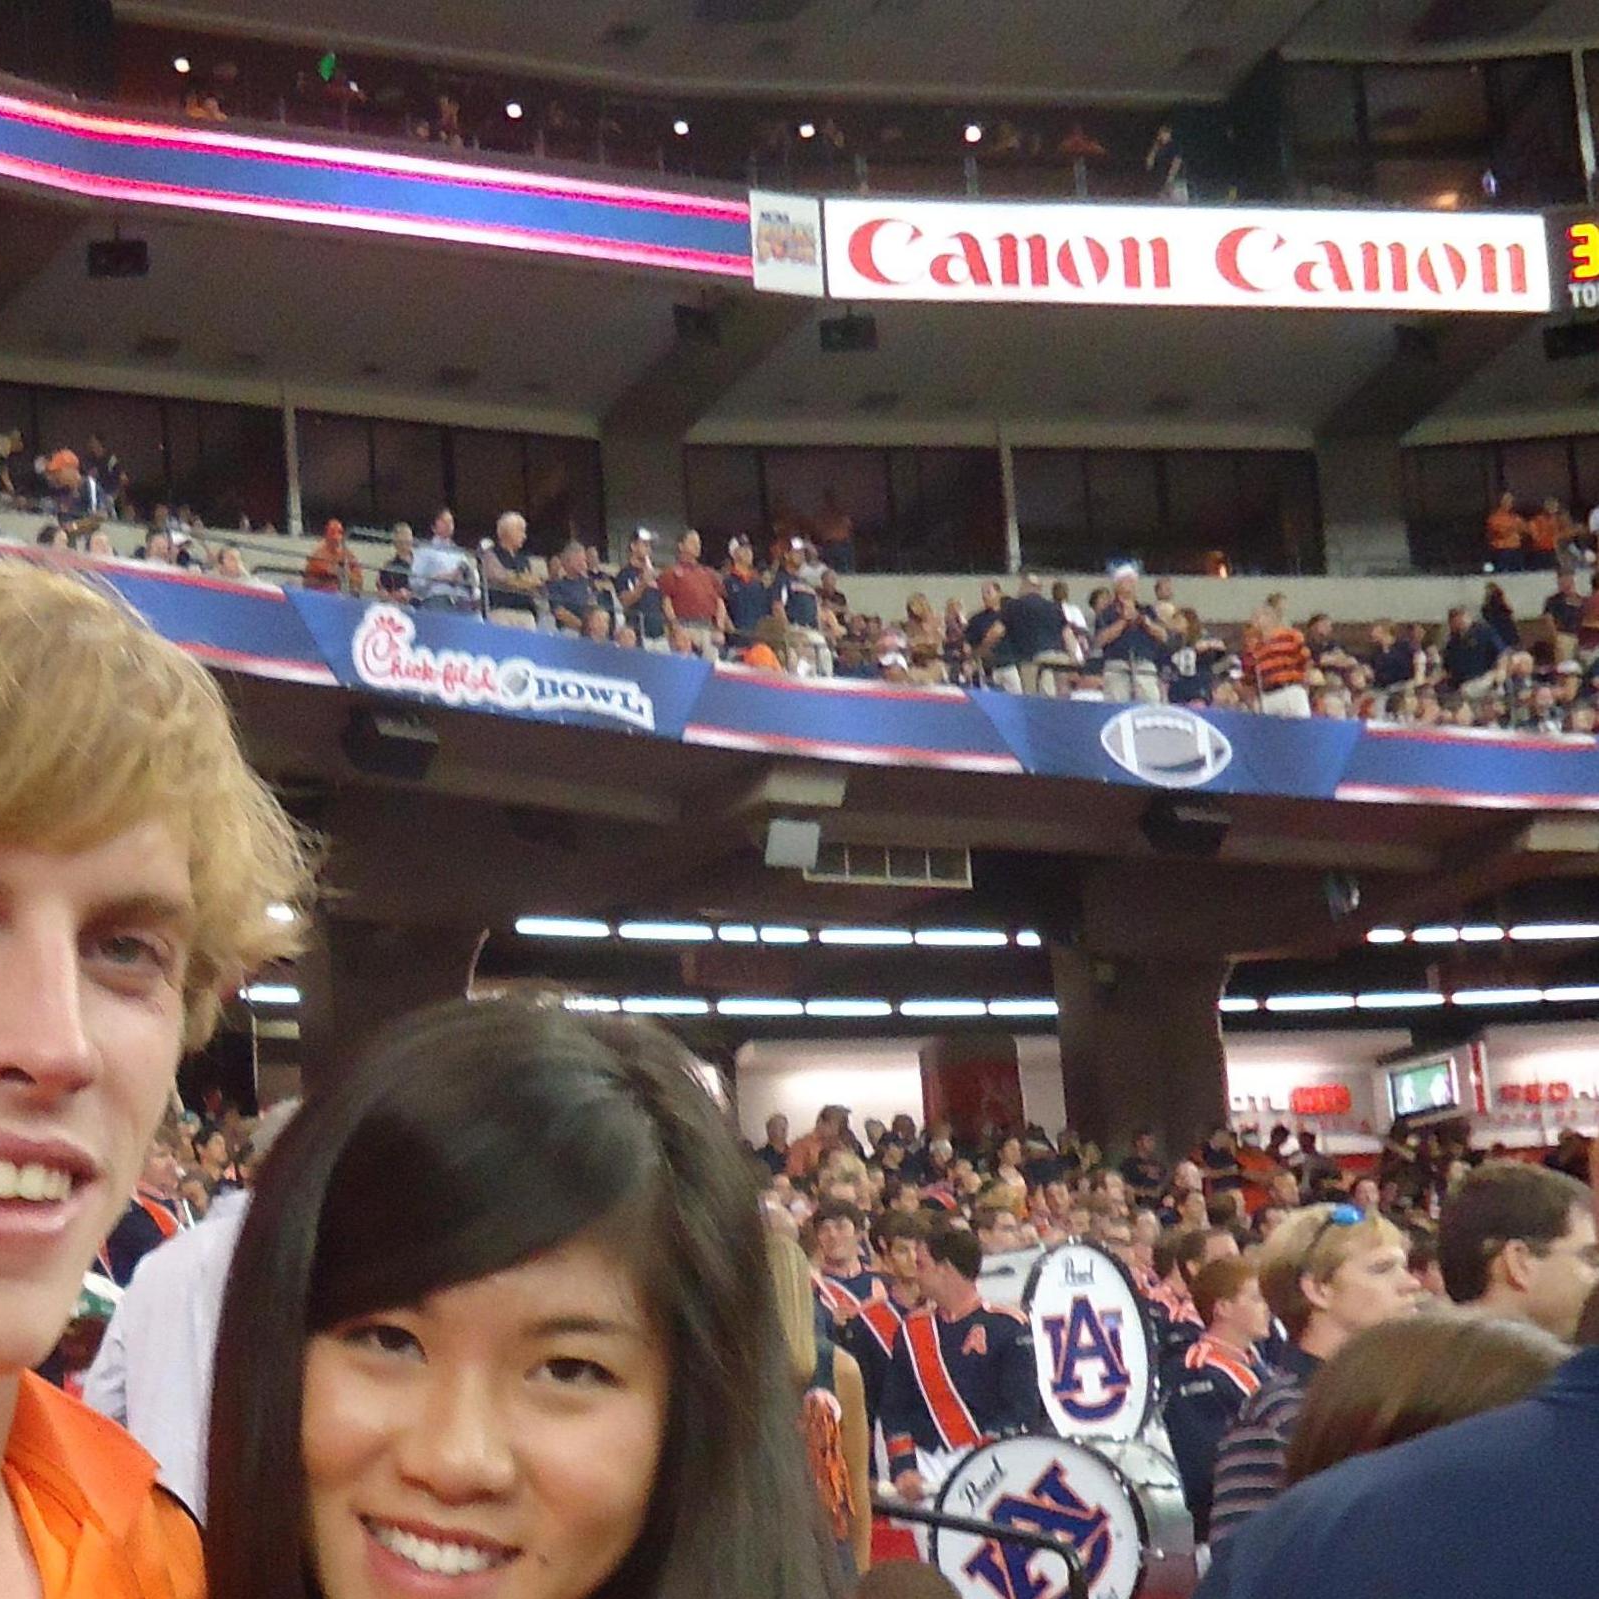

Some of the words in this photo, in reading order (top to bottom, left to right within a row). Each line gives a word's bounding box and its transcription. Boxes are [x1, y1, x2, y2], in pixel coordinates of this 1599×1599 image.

[848, 218, 1171, 289] Canon
[1216, 227, 1527, 294] Canon
[362, 616, 497, 695] Chick-fil-A
[537, 677, 645, 717] BOWL
